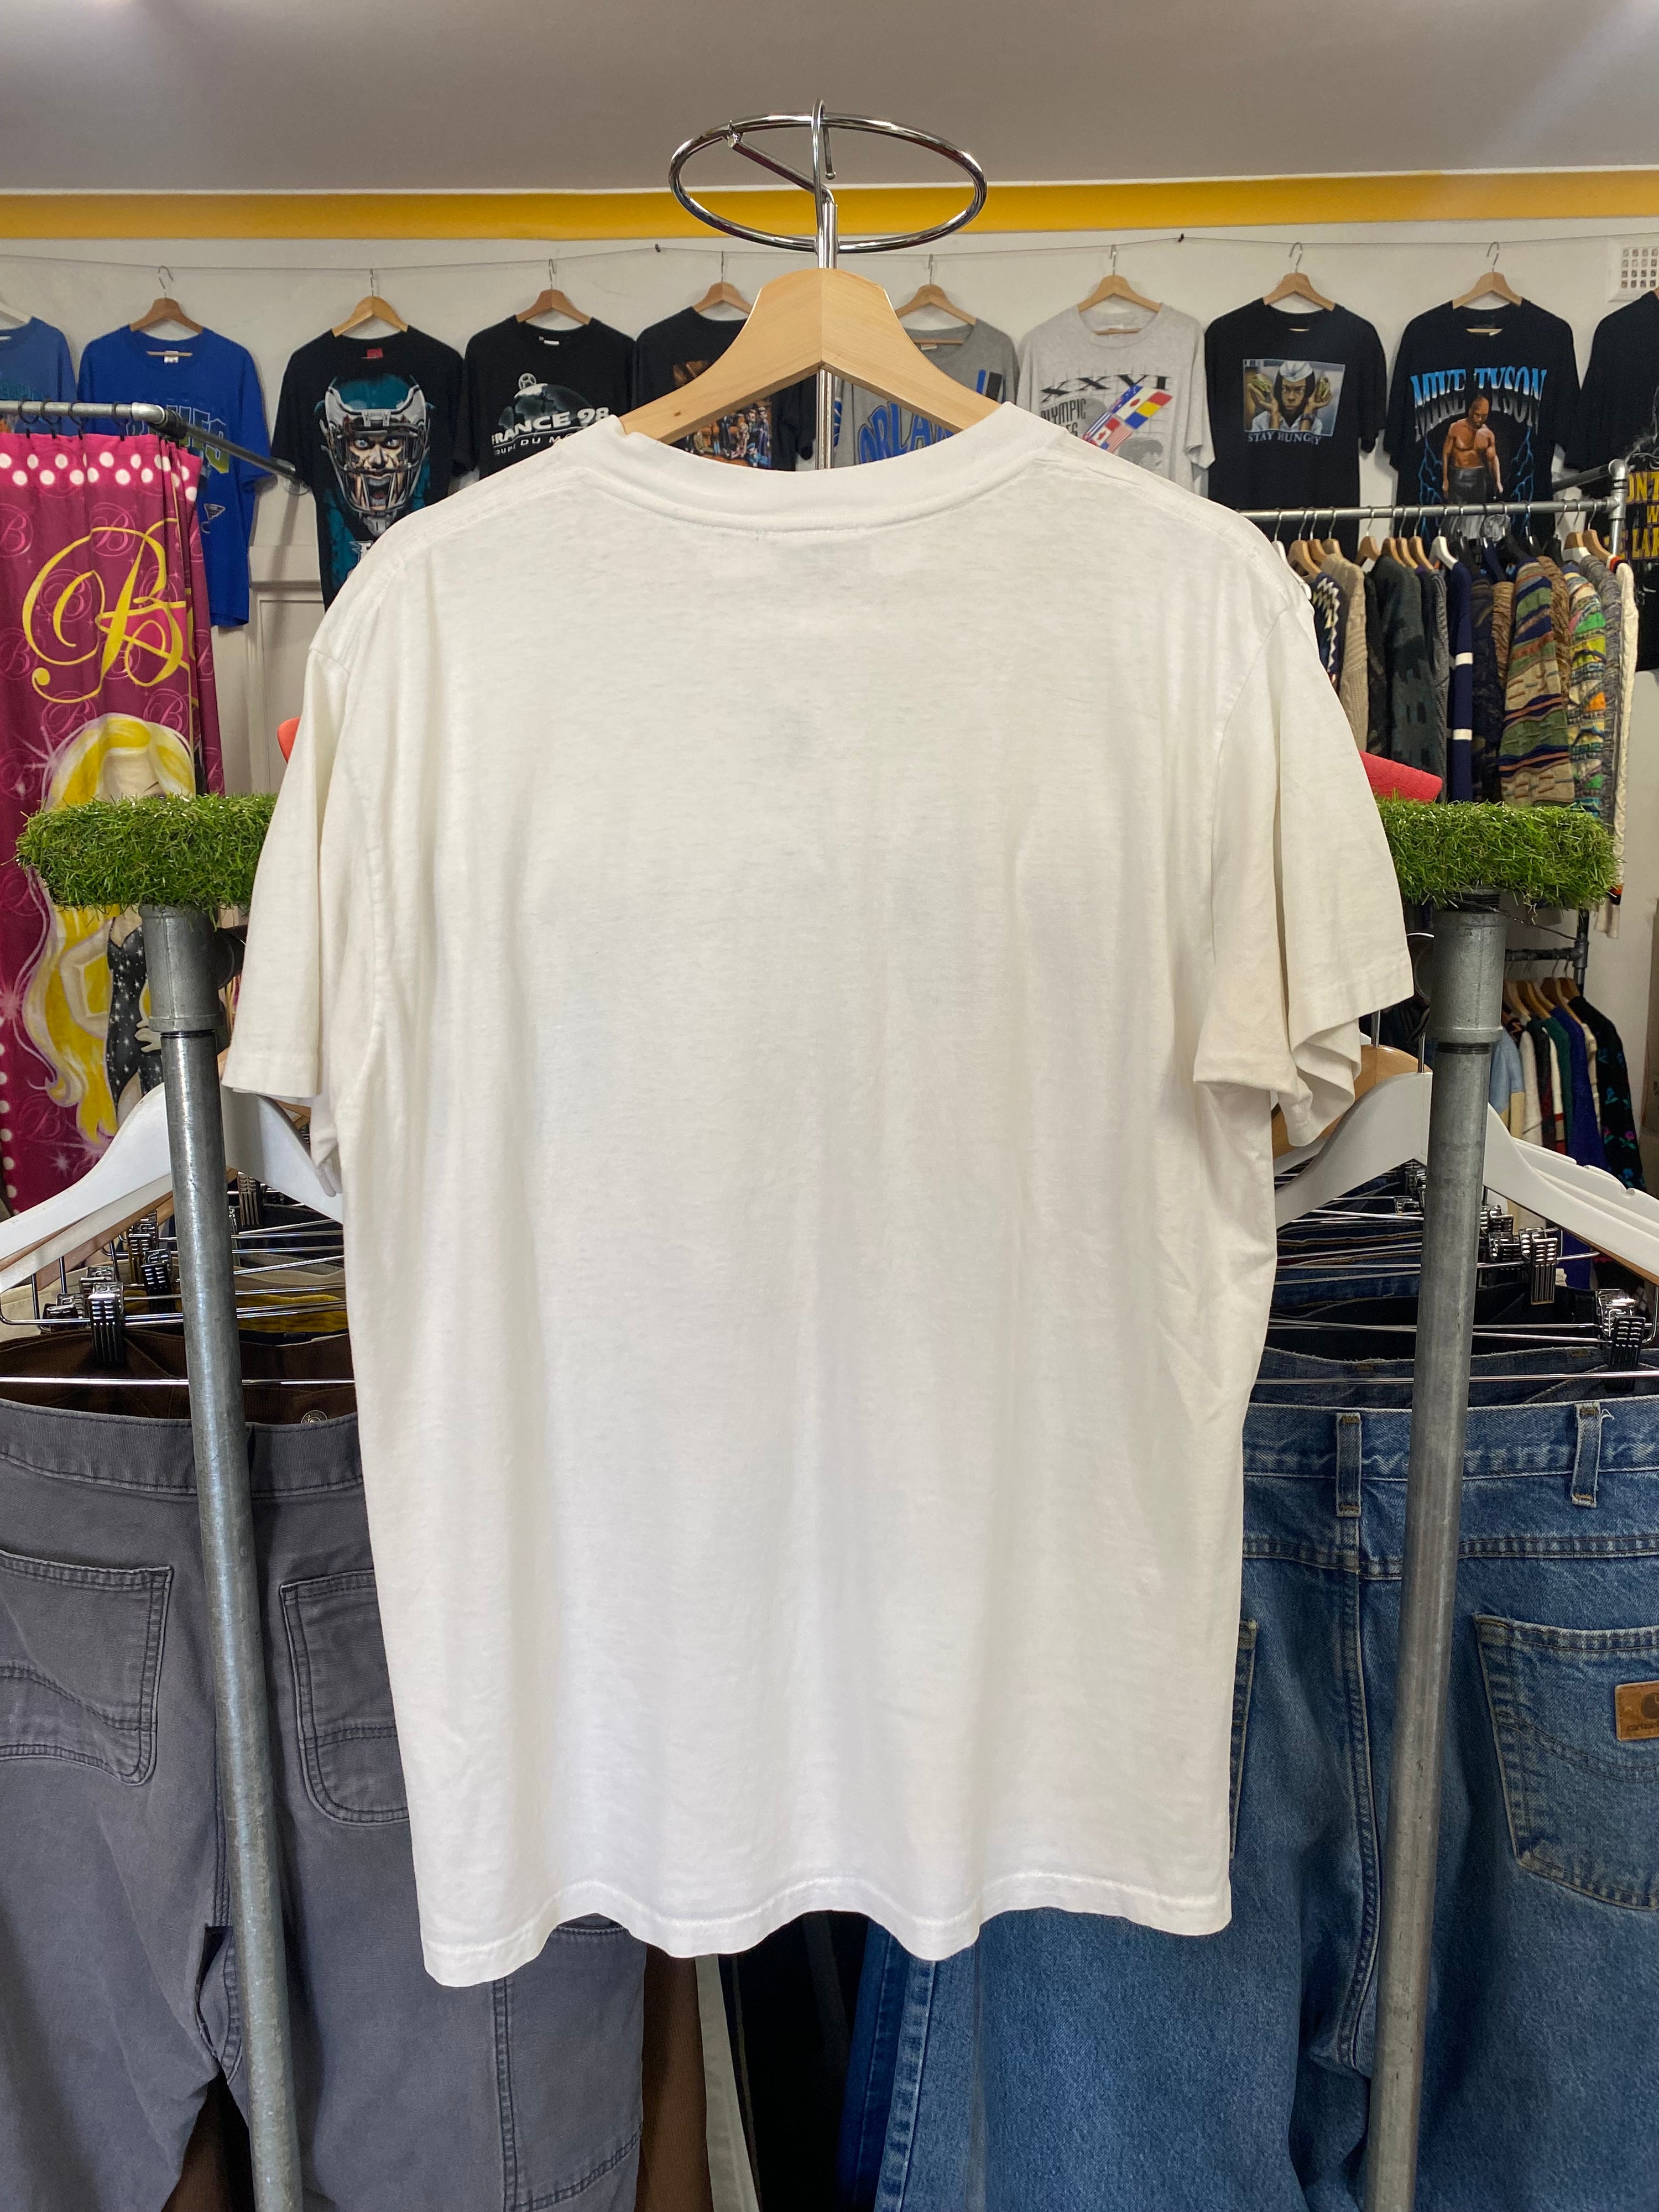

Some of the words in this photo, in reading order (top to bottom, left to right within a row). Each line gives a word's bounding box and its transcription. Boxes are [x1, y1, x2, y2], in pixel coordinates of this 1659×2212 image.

[1040, 373, 1172, 403] XXVI
[1410, 369, 1467, 442] MIKE
[1473, 365, 1547, 435] TYSON
[494, 442, 516, 456] OUP
[520, 437, 541, 446] DU
[1248, 431, 1275, 442] STAY
